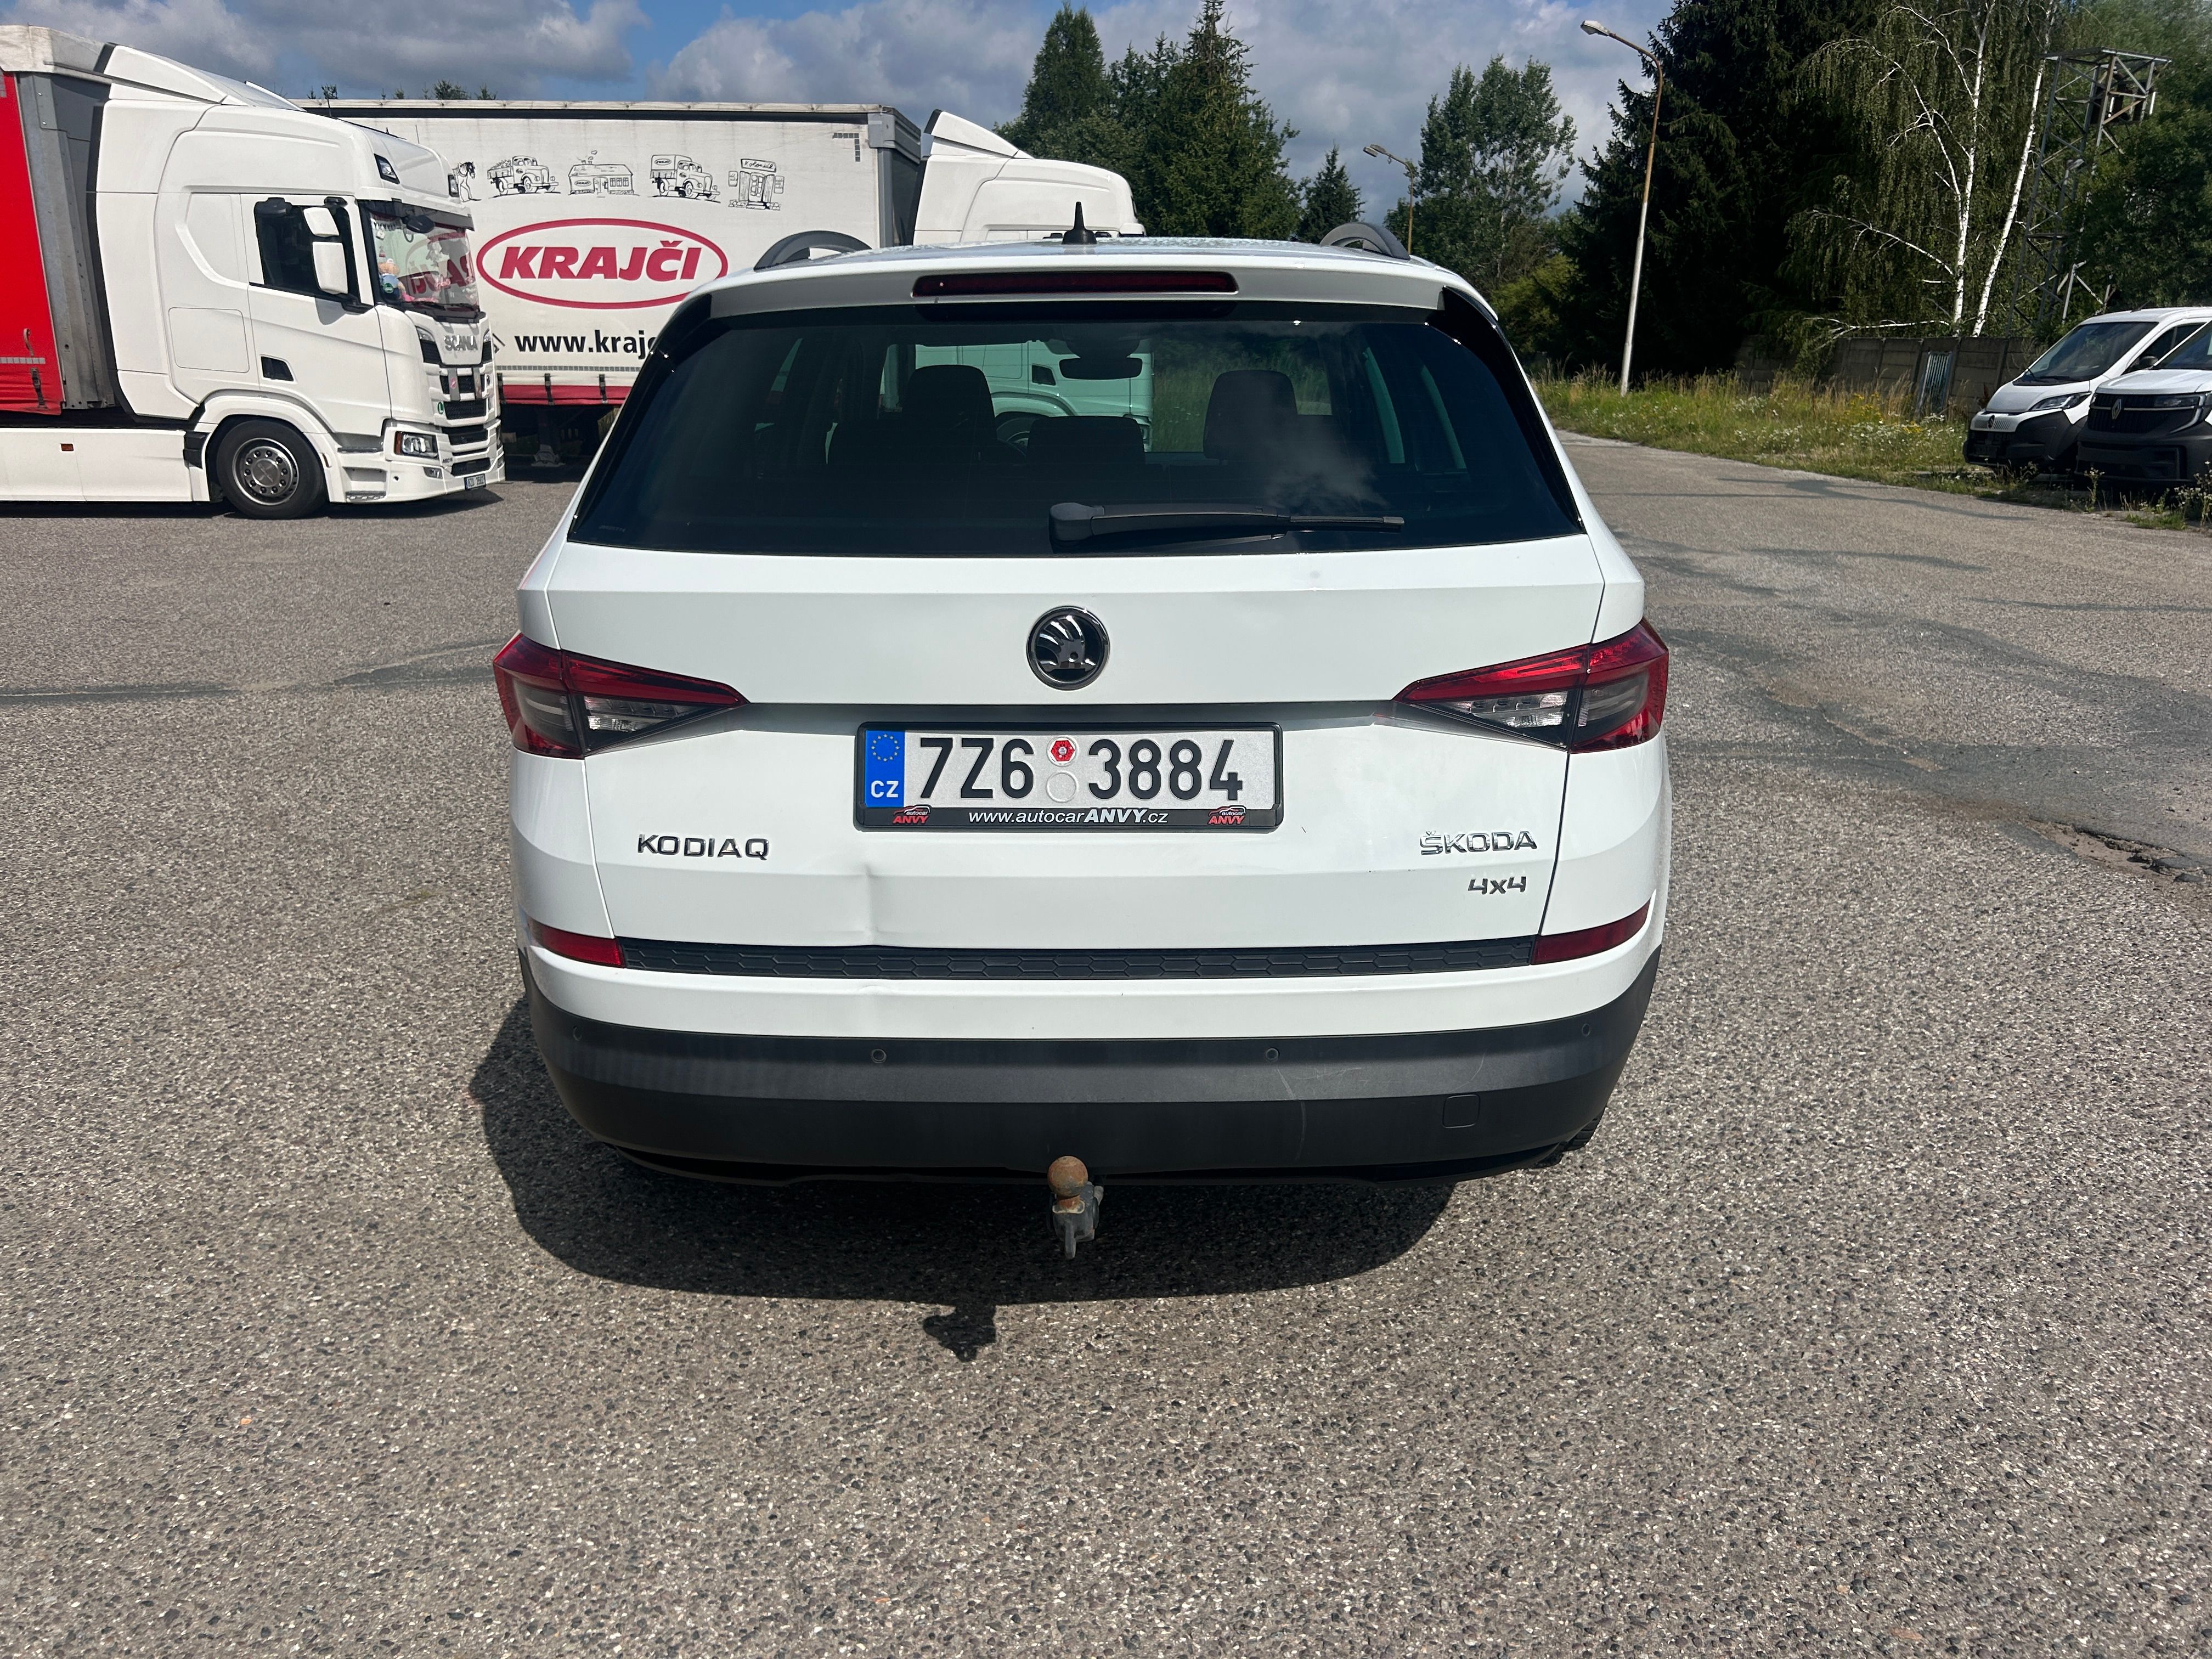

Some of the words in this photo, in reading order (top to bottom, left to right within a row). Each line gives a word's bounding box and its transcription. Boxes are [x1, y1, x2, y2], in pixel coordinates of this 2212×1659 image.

[499, 240, 702, 281] KRAJČI
[444, 335, 478, 351] SCANIA
[921, 737, 1034, 799] 7Z6
[1088, 738, 1243, 800] 3884
[871, 781, 899, 798] CZ
[893, 816, 929, 825] ANVY
[969, 809, 1168, 823] www.autocarANVY.cz
[1208, 816, 1245, 825] ANVY
[637, 834, 769, 860] KODIAQ
[1420, 831, 1537, 855] ŠKODA
[1468, 876, 1527, 895] 4x4
